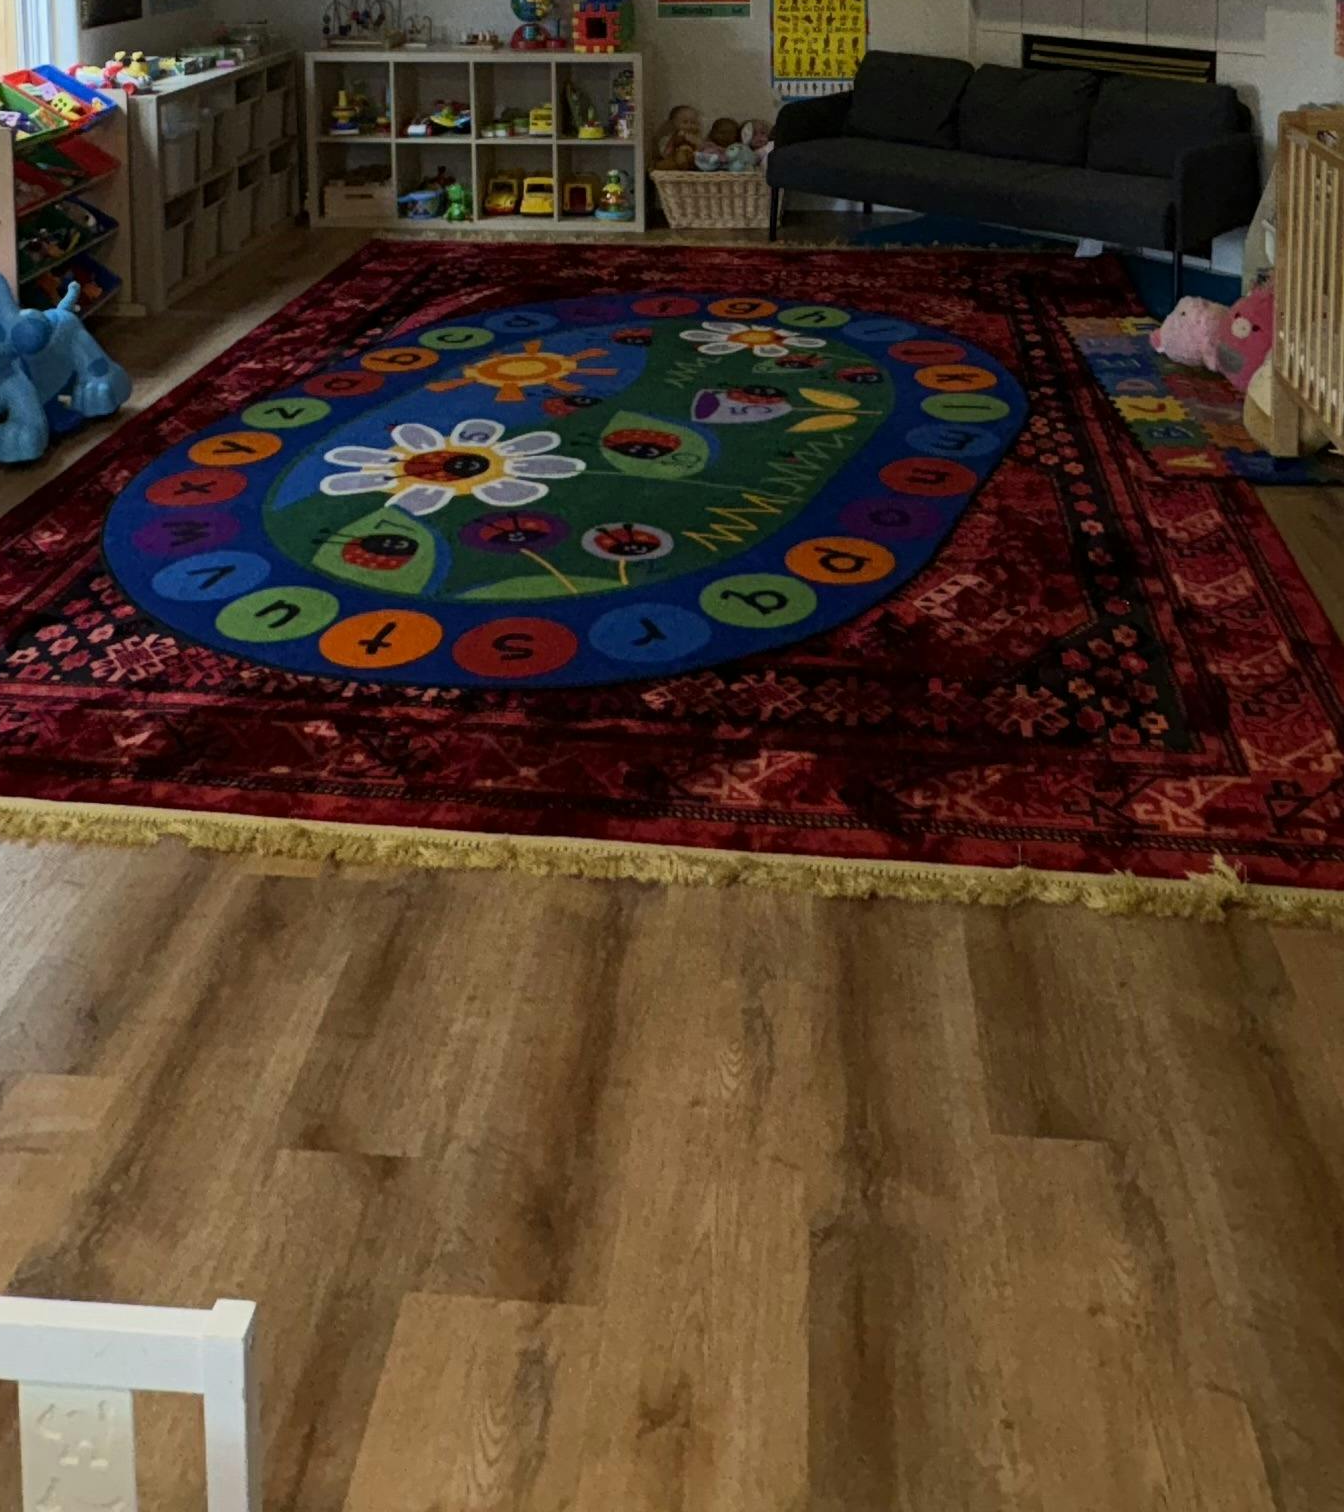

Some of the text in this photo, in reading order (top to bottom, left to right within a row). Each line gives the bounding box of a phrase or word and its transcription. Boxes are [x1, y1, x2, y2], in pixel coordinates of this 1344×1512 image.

[727, 301, 760, 315] g
[436, 332, 474, 345] c
[371, 350, 421, 366] b
[935, 372, 976, 384] k
[263, 404, 305, 422] z
[212, 440, 254, 457] y
[173, 479, 217, 495] x
[814, 545, 871, 574] p
[185, 563, 236, 590] v
[255, 599, 301, 629] u
[358, 620, 397, 656] t
[632, 616, 666, 647] r
[491, 632, 534, 661] s
